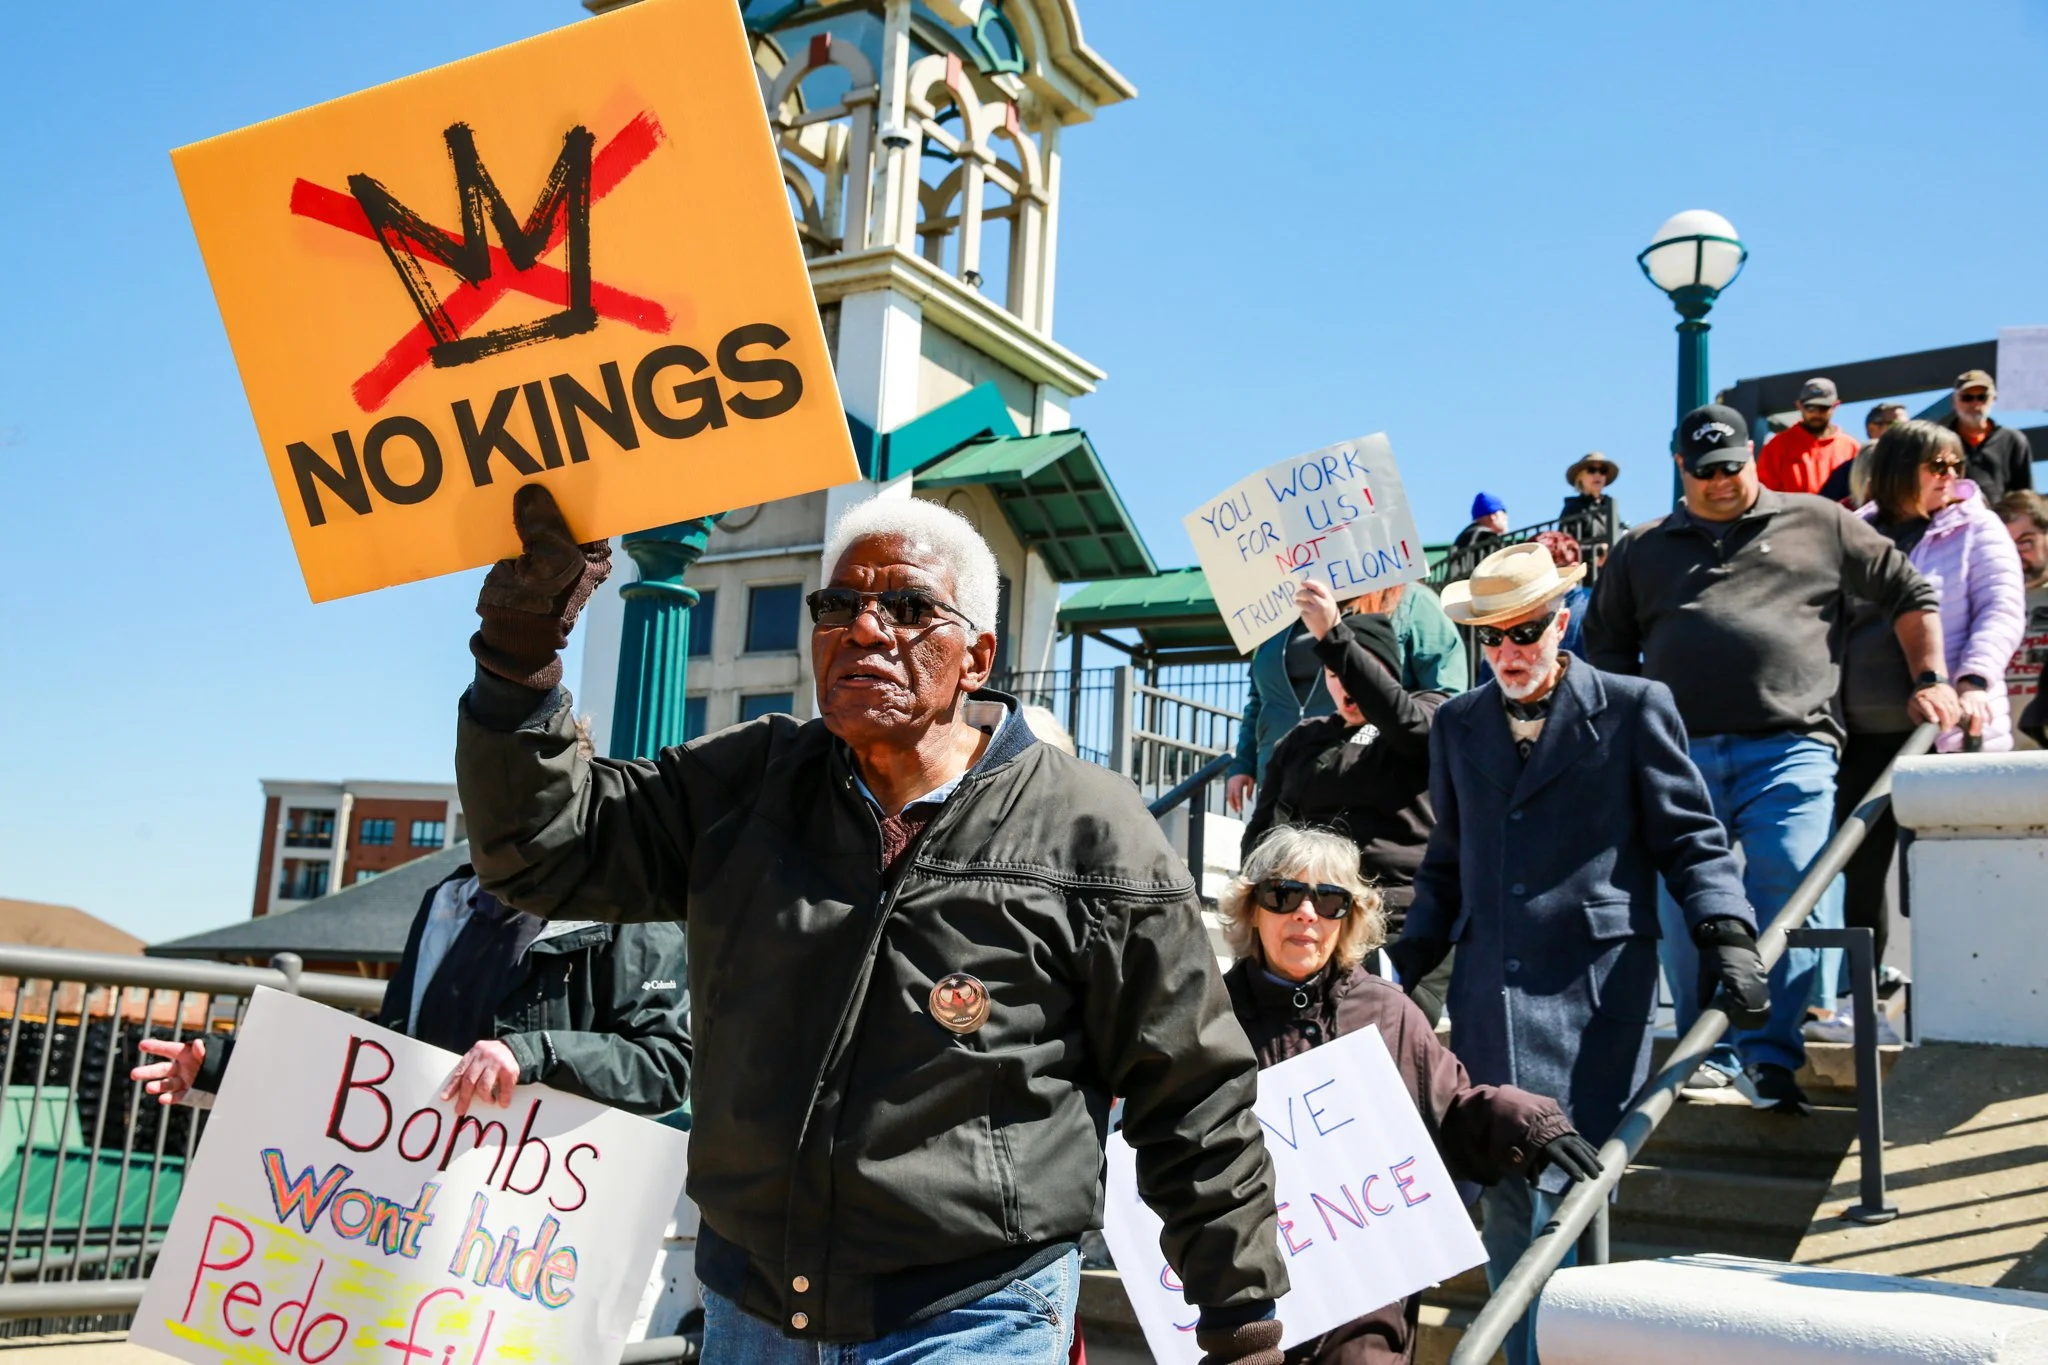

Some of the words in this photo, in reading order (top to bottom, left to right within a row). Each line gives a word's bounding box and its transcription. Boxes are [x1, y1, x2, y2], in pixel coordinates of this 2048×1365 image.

[286, 415, 444, 527] NO
[450, 323, 804, 487] KINGS
[1201, 491, 1252, 538] YOU
[1265, 449, 1370, 503] WORK
[1236, 521, 1280, 562] FOR
[1305, 488, 1376, 531] US!
[1232, 580, 1297, 636] TRUMP
[1327, 540, 1413, 590] ELON!
[1274, 536, 1327, 576] NOT
[326, 1034, 600, 1212] Bombs
[1257, 1078, 1355, 1150] VE
[260, 1147, 442, 1259] Wont
[449, 1191, 579, 1310] hide
[181, 1214, 349, 1364] Pedo
